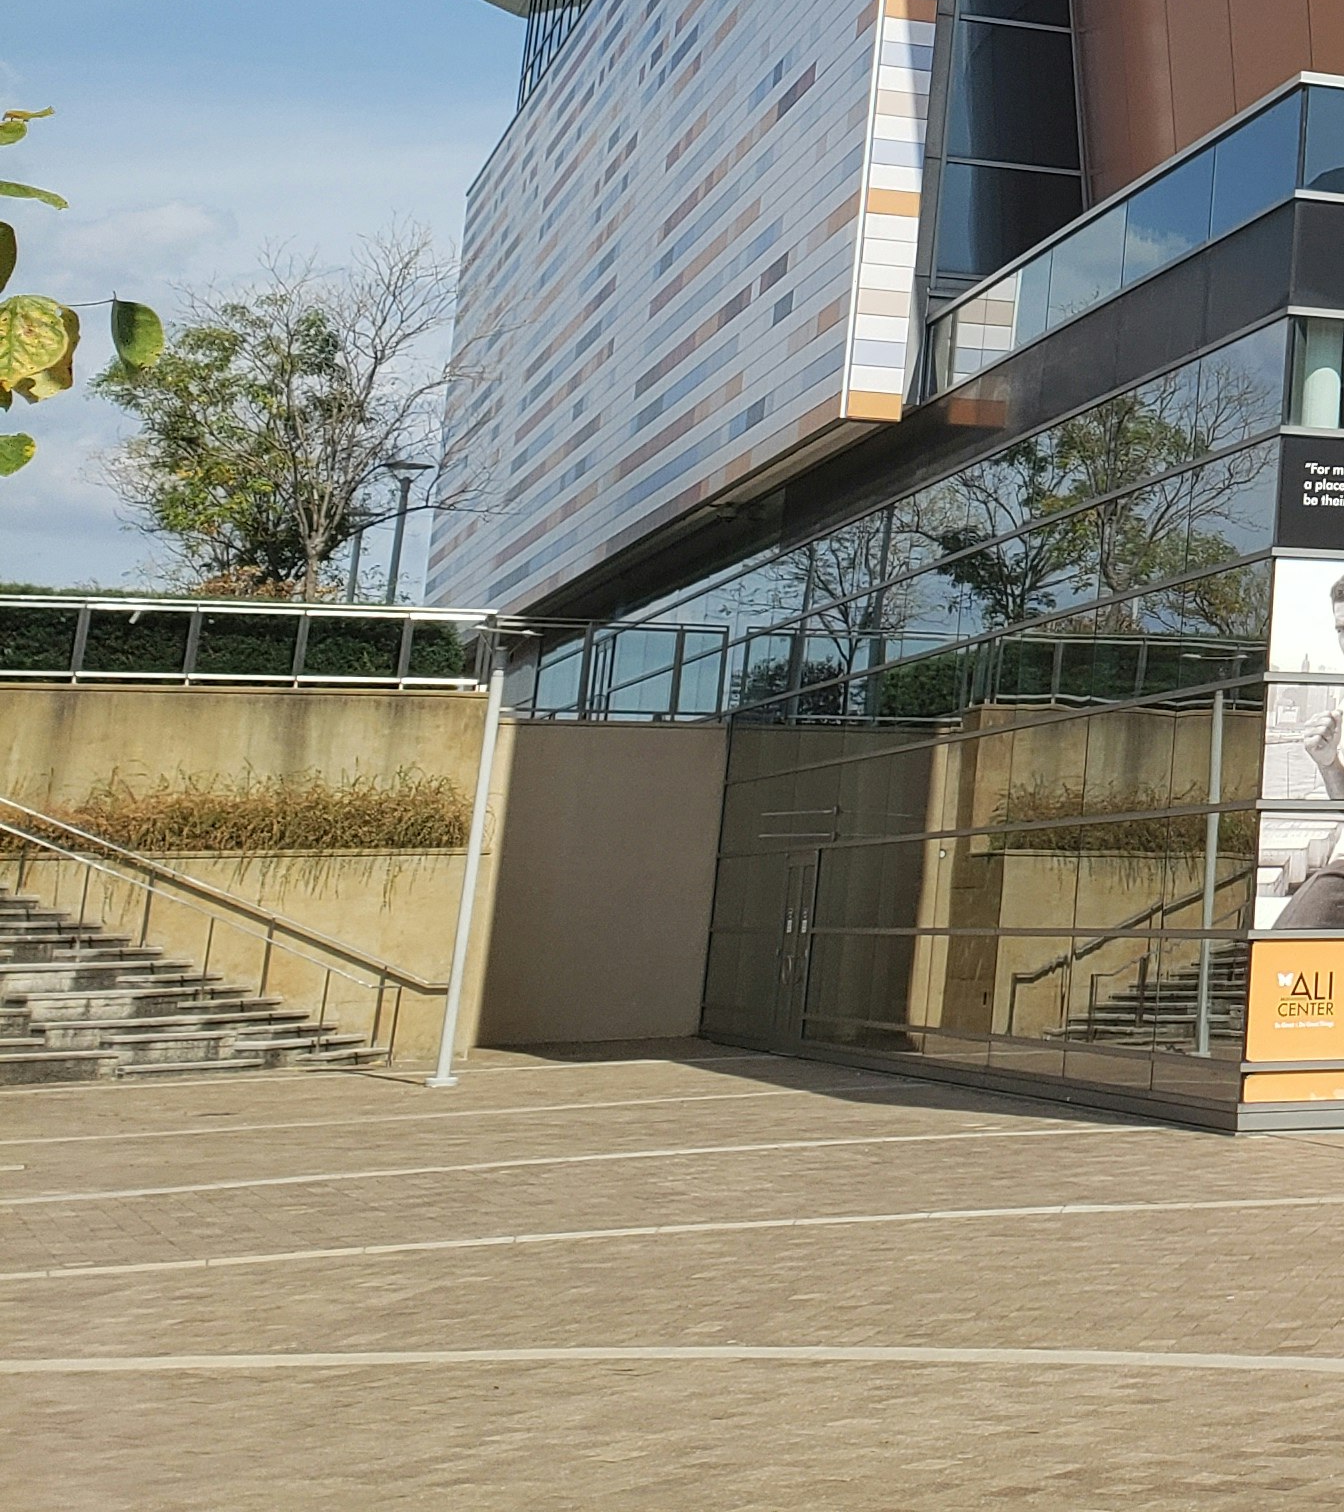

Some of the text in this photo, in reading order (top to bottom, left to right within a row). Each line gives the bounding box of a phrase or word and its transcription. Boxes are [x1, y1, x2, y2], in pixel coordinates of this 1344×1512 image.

[1303, 481, 1312, 490] a
[1303, 493, 1319, 506] be
[1290, 971, 1334, 1000] ALI
[1277, 1002, 1334, 1017] CENTER
